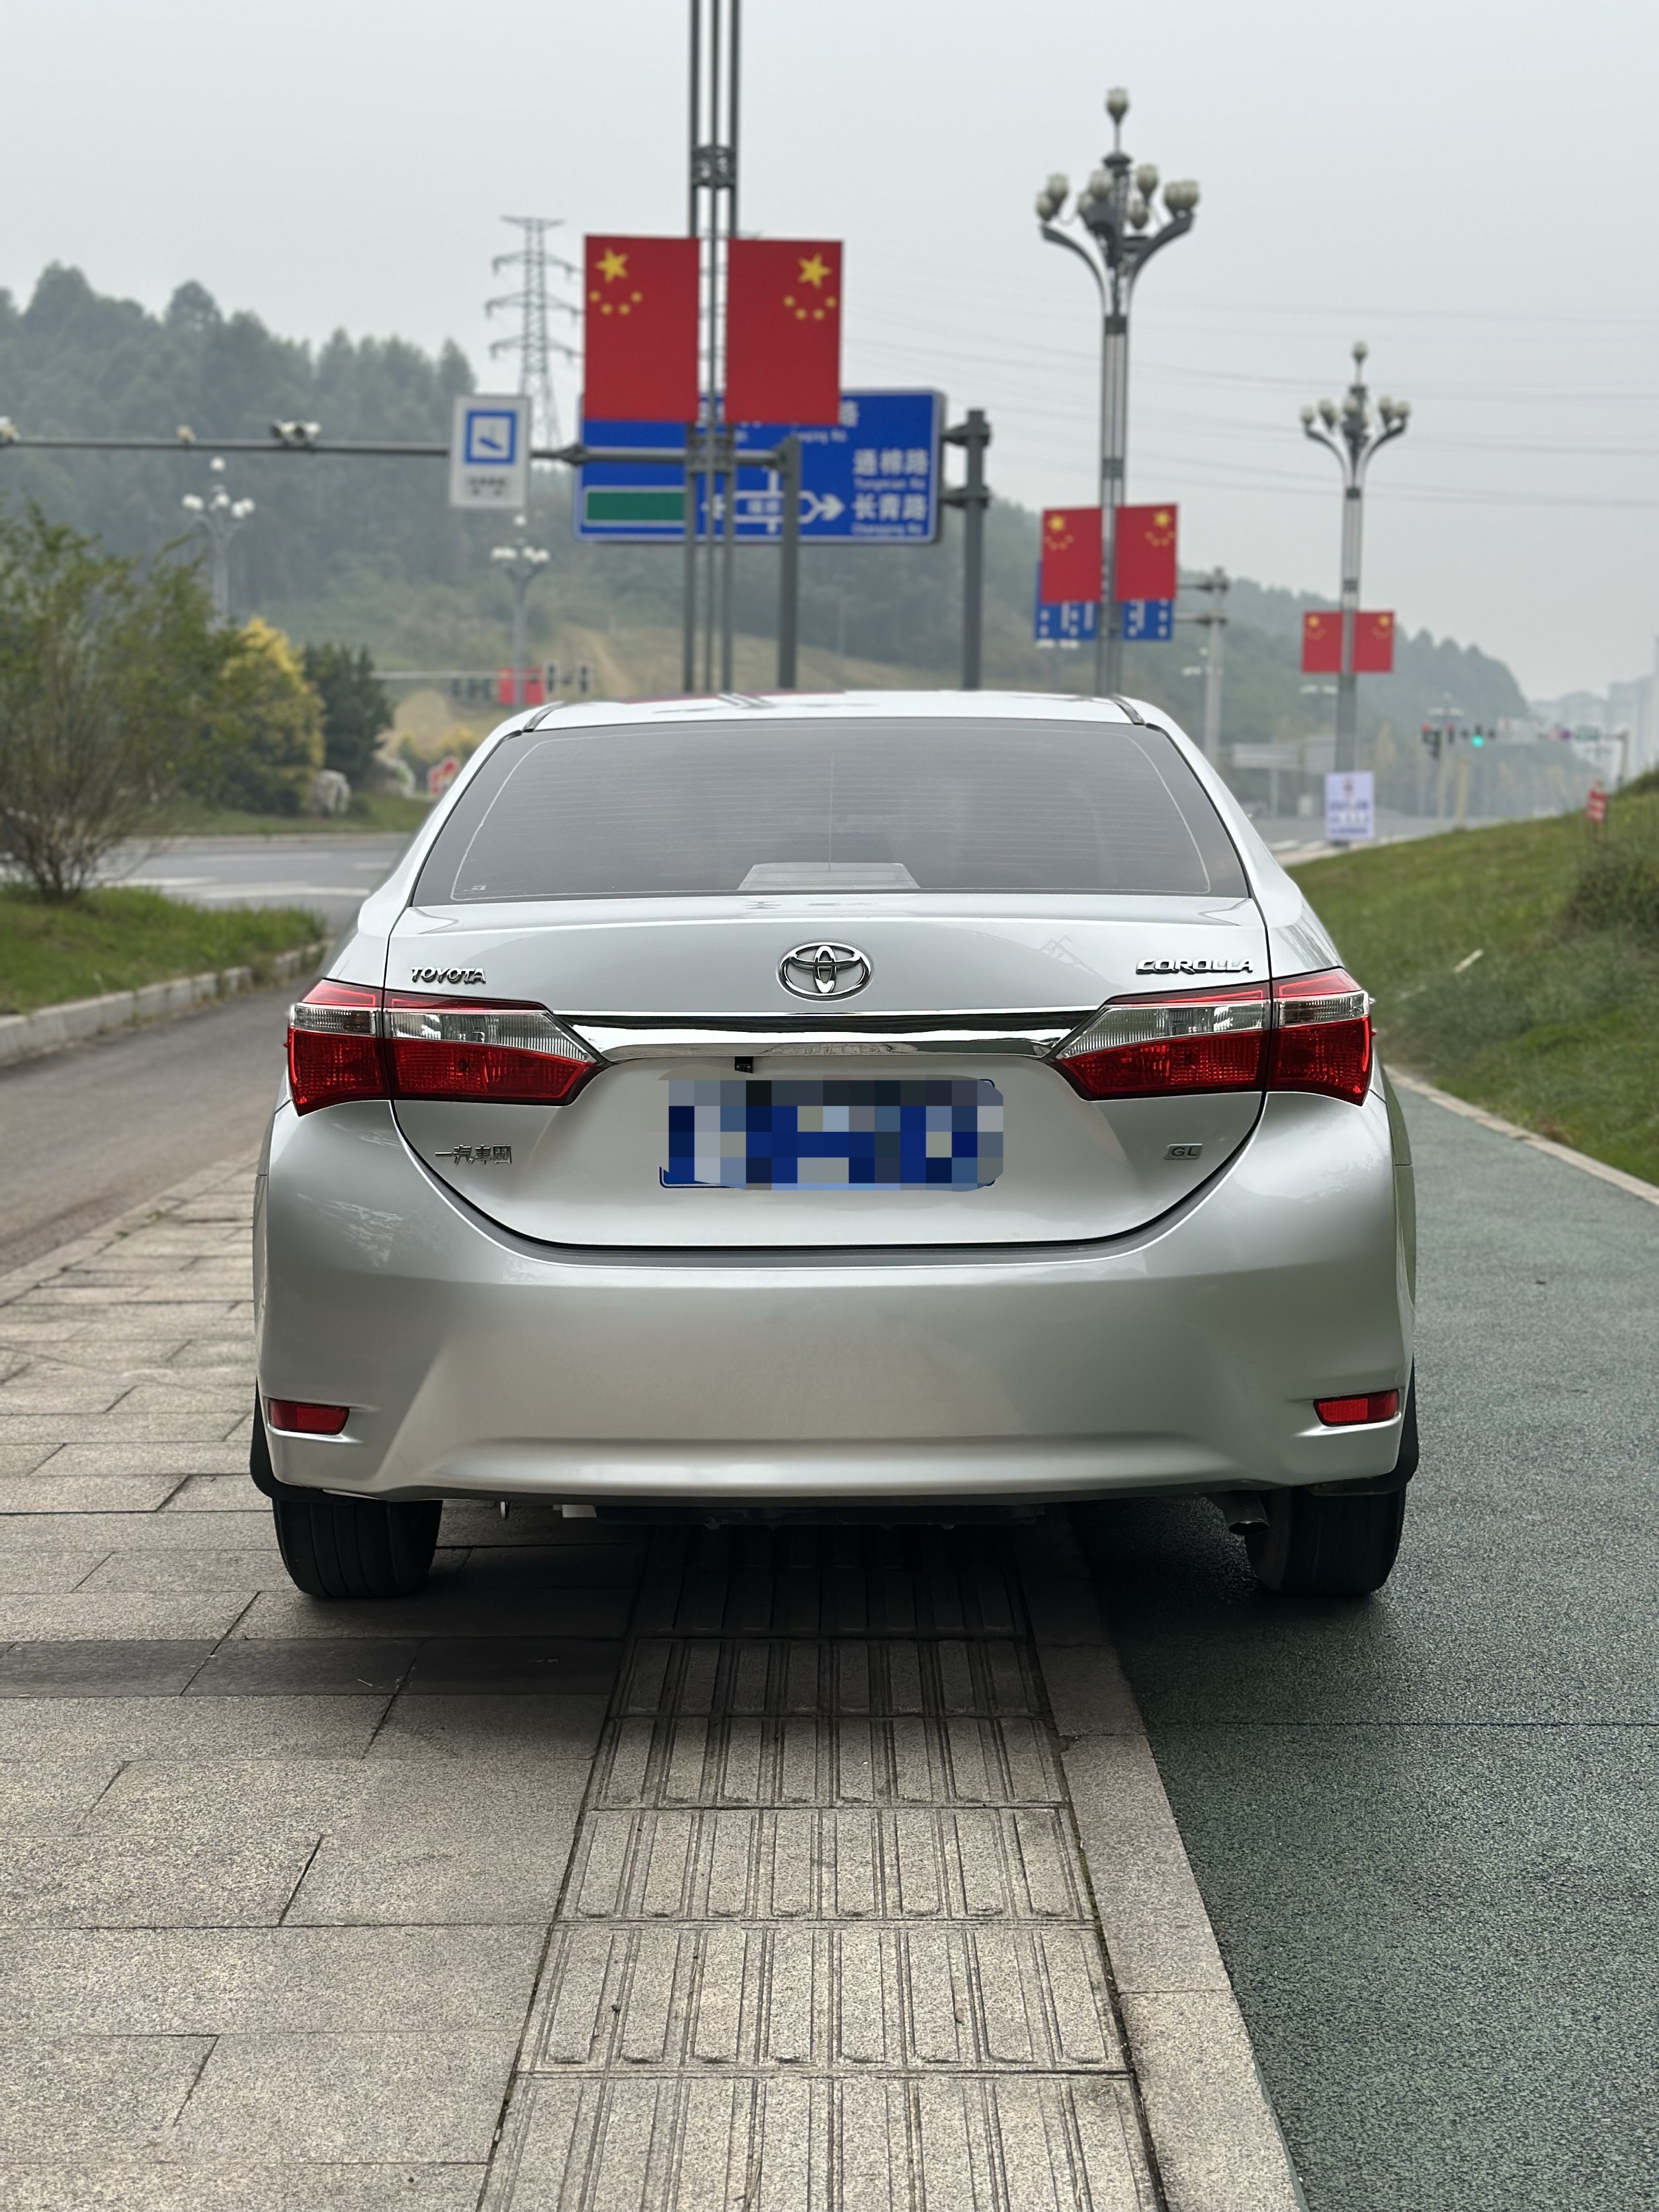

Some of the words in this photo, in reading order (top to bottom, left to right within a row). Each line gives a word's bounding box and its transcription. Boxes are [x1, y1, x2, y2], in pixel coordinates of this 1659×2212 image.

[411, 966, 486, 984] TOYOTA
[1135, 958, 1254, 975] COROLLA
[1171, 1146, 1197, 1157] GL
